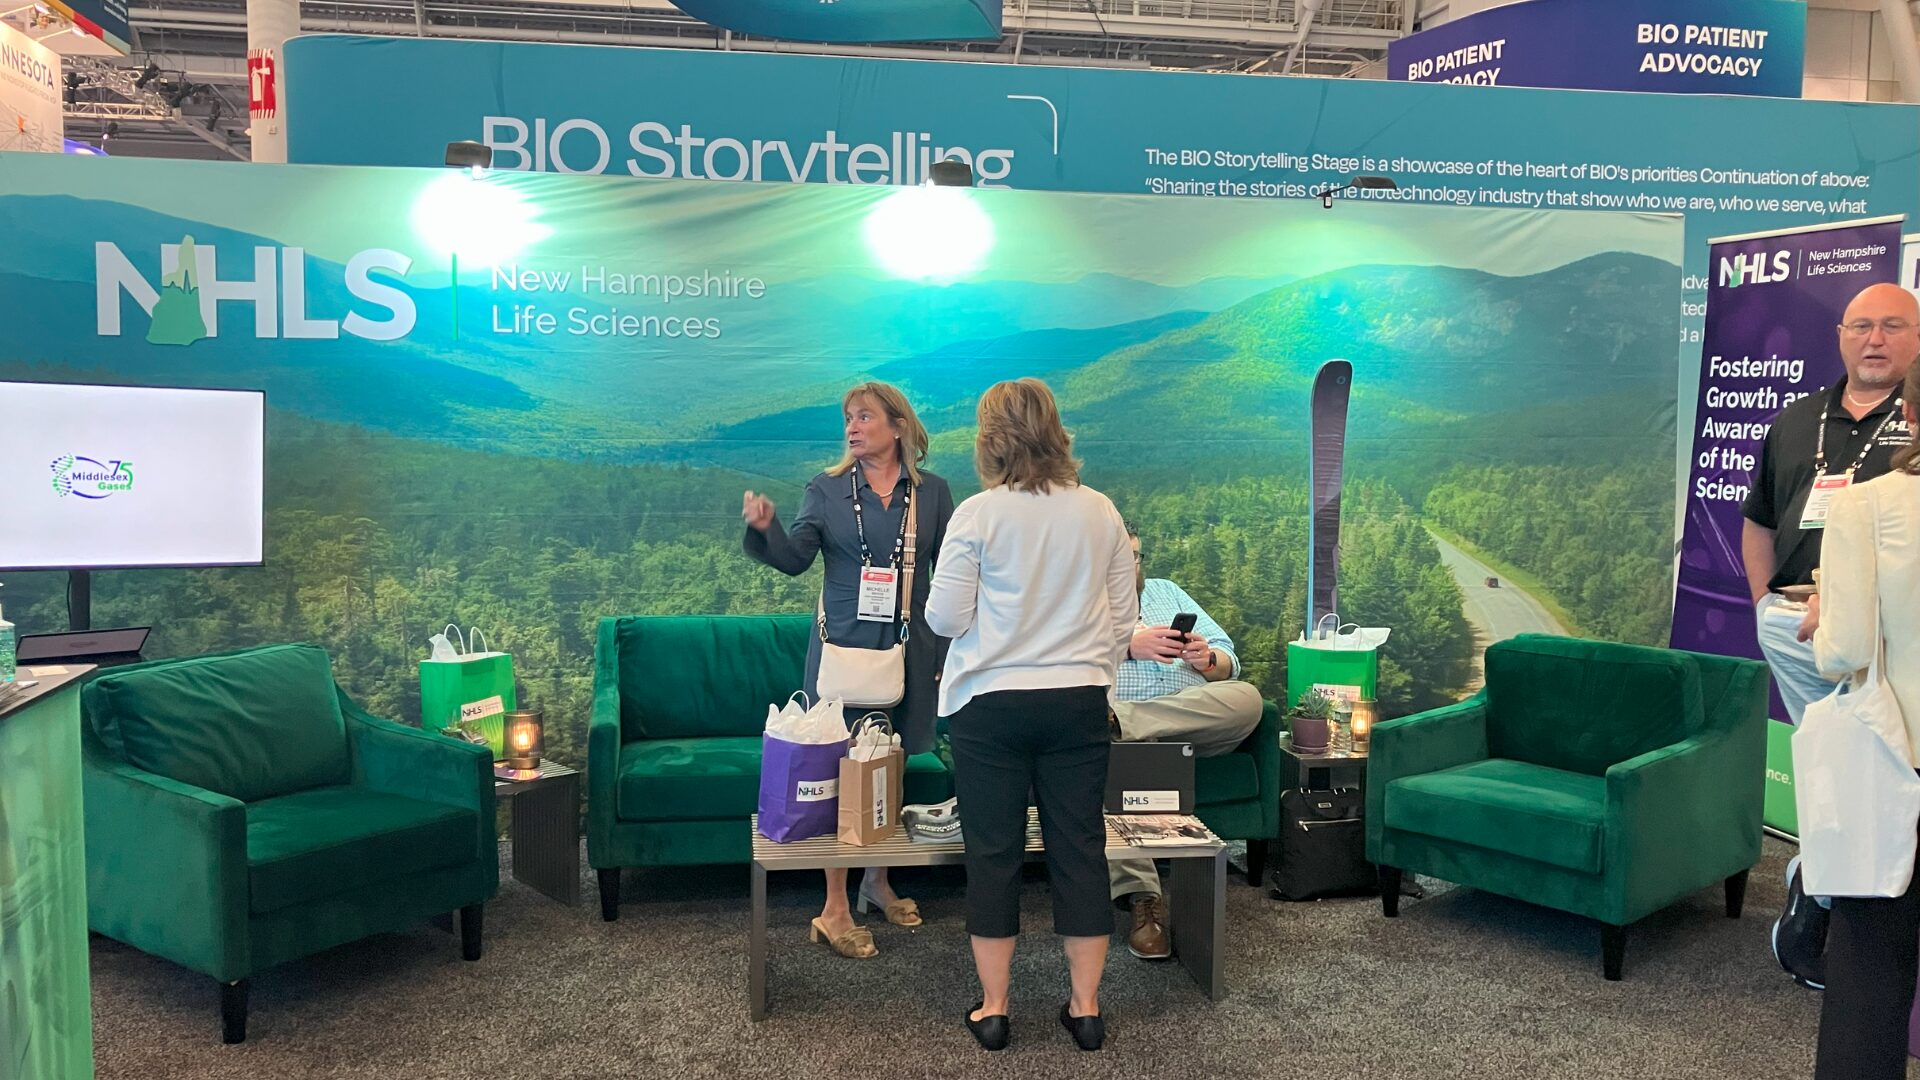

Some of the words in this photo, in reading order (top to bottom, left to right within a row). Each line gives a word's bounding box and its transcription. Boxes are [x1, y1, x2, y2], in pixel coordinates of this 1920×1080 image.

[1637, 23, 1679, 44] BIO
[1685, 25, 1768, 49] PATIENT
[1408, 59, 1433, 80] BIO
[1436, 39, 1505, 73] PATIENT
[1639, 52, 1762, 77] ADVOCACY
[482, 116, 610, 174] BIO
[1145, 149, 1177, 166] The
[1181, 150, 1211, 167] BIO
[1214, 150, 1308, 172] Storytelling
[1311, 154, 1359, 173] Stage
[1362, 155, 1375, 171] is
[1378, 159, 1388, 171] a
[1391, 157, 1473, 174] showcase
[1476, 159, 1494, 175] of
[1496, 160, 1523, 176] the
[1525, 161, 1567, 179] heart
[1570, 163, 1587, 179] of
[1590, 164, 1629, 181] BIO's
[1632, 166, 1697, 183] priorities
[1700, 168, 1798, 186] Continuation
[1801, 171, 1818, 186] of
[1820, 172, 1870, 188] above:
[1218, 180, 1247, 196] the
[1250, 181, 1306, 197] stories
[1480, 187, 1544, 208] industry
[1546, 190, 1578, 206] that
[1580, 192, 1623, 207] show
[1626, 193, 1660, 208] who
[1664, 197, 1686, 209] we
[1689, 197, 1716, 213] are,
[1719, 195, 1753, 211] who
[1756, 200, 1779, 212] we
[1781, 201, 1826, 216] serve,
[1829, 199, 1867, 214] what
[1809, 250, 1831, 262] New
[1833, 244, 1886, 260] Hampshire
[1719, 250, 1791, 287] NHLS
[1807, 264, 1825, 276] Life
[1827, 261, 1872, 275] Sciences
[95, 240, 417, 342] NHLS
[491, 264, 571, 292] New
[582, 266, 766, 303] Hampshire
[492, 304, 557, 334] Life
[567, 307, 721, 339] Sciences
[1709, 354, 1804, 383] Fostering
[1706, 386, 1778, 409] Growth
[1699, 446, 1719, 469] of
[1721, 447, 1755, 471] the
[72, 472, 128, 481] Middlesex
[98, 482, 132, 490] Gases
[109, 460, 133, 487] 75
[463, 706, 482, 717] NHLS
[798, 786, 824, 796] NHLS
[1123, 796, 1149, 805] NHLS
